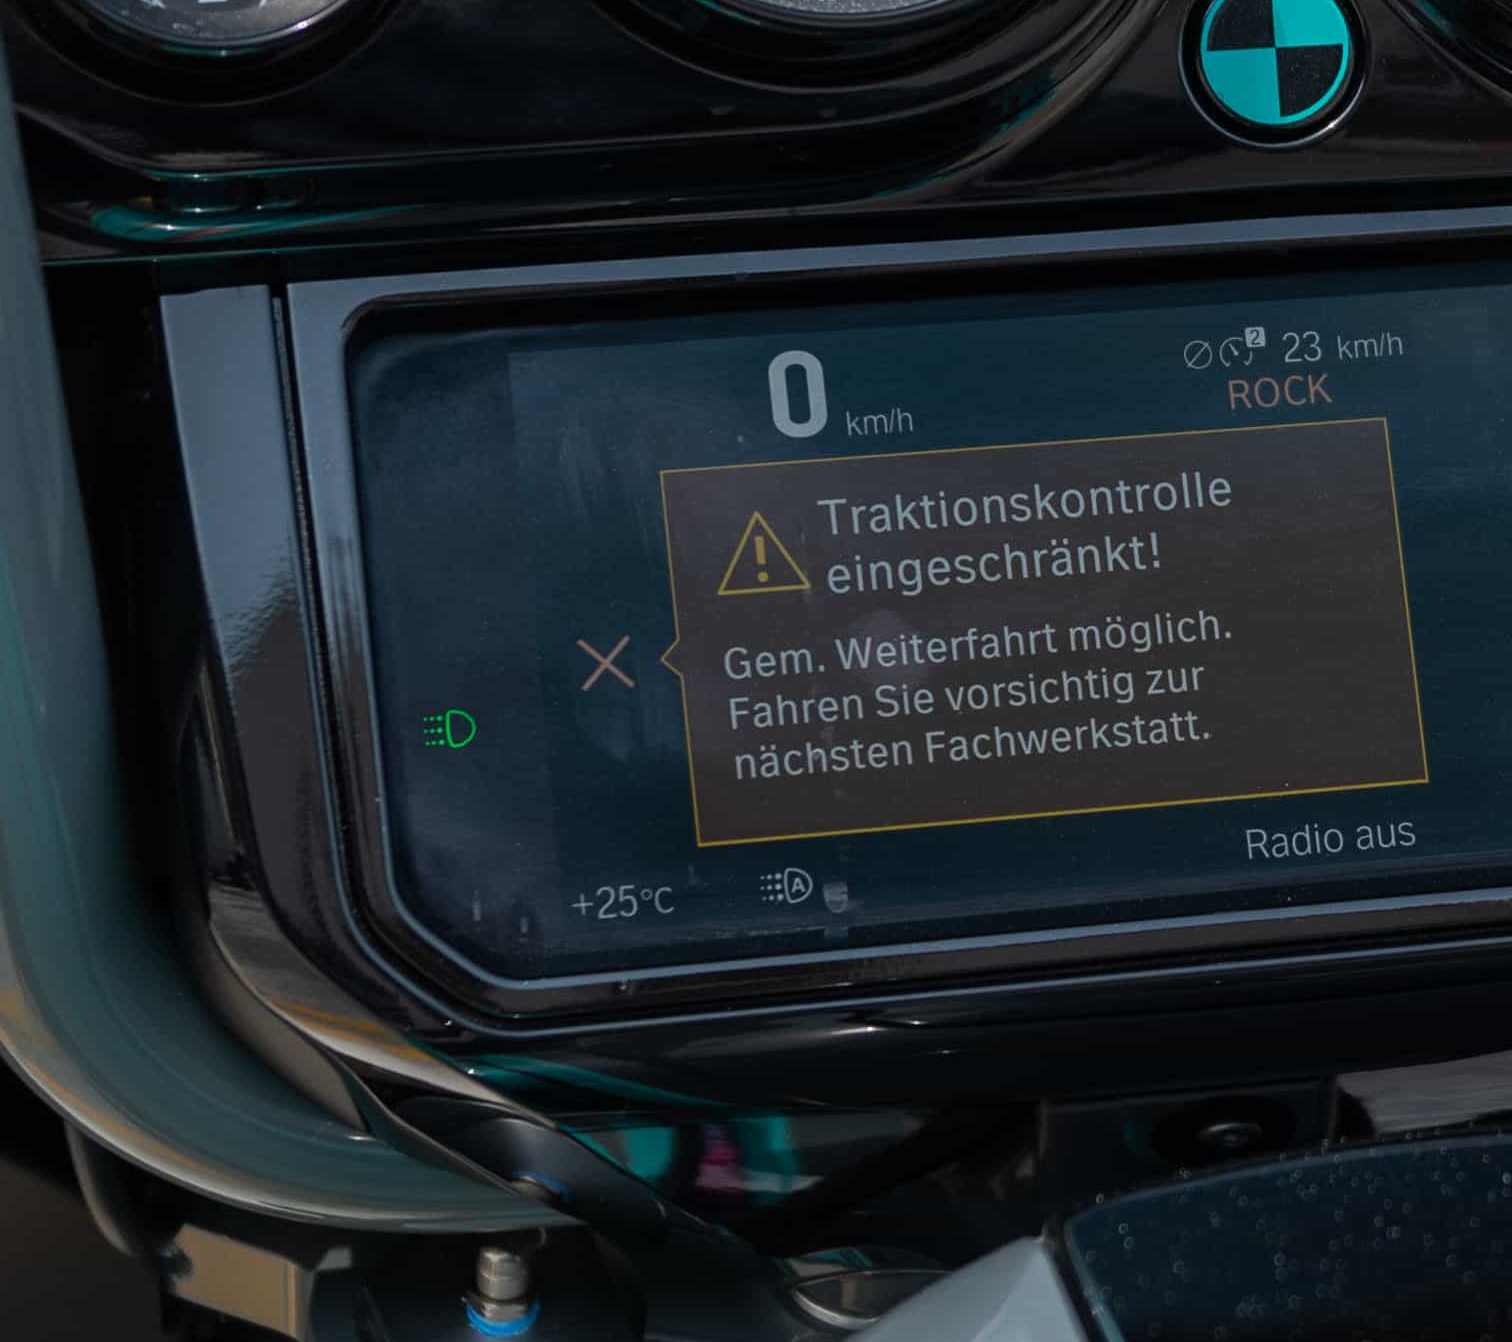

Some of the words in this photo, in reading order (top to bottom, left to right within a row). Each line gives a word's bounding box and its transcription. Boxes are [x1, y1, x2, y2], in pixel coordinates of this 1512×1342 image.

[1281, 330, 1323, 364] 23
[1336, 331, 1405, 362] km/h
[767, 349, 828, 439] 0
[845, 407, 915, 436] km/h
[1227, 373, 1334, 412] ROCK
[818, 470, 1233, 537] Traktionskontrolle
[826, 531, 1163, 597] eingeschränkt!
[723, 640, 827, 683] Gem.
[834, 622, 1058, 673] Weiterfahrt
[1067, 608, 1234, 658] möglich.
[728, 694, 865, 731] Fahren
[875, 685, 935, 720] Sie
[944, 669, 1136, 713] vorsichtig
[1145, 664, 1207, 696] zur
[733, 734, 915, 781] nächsten
[925, 709, 1214, 766] Fachwerkstatt.
[1245, 824, 1346, 861] Radio
[1355, 820, 1418, 853] aus
[571, 884, 676, 920] +25°C
